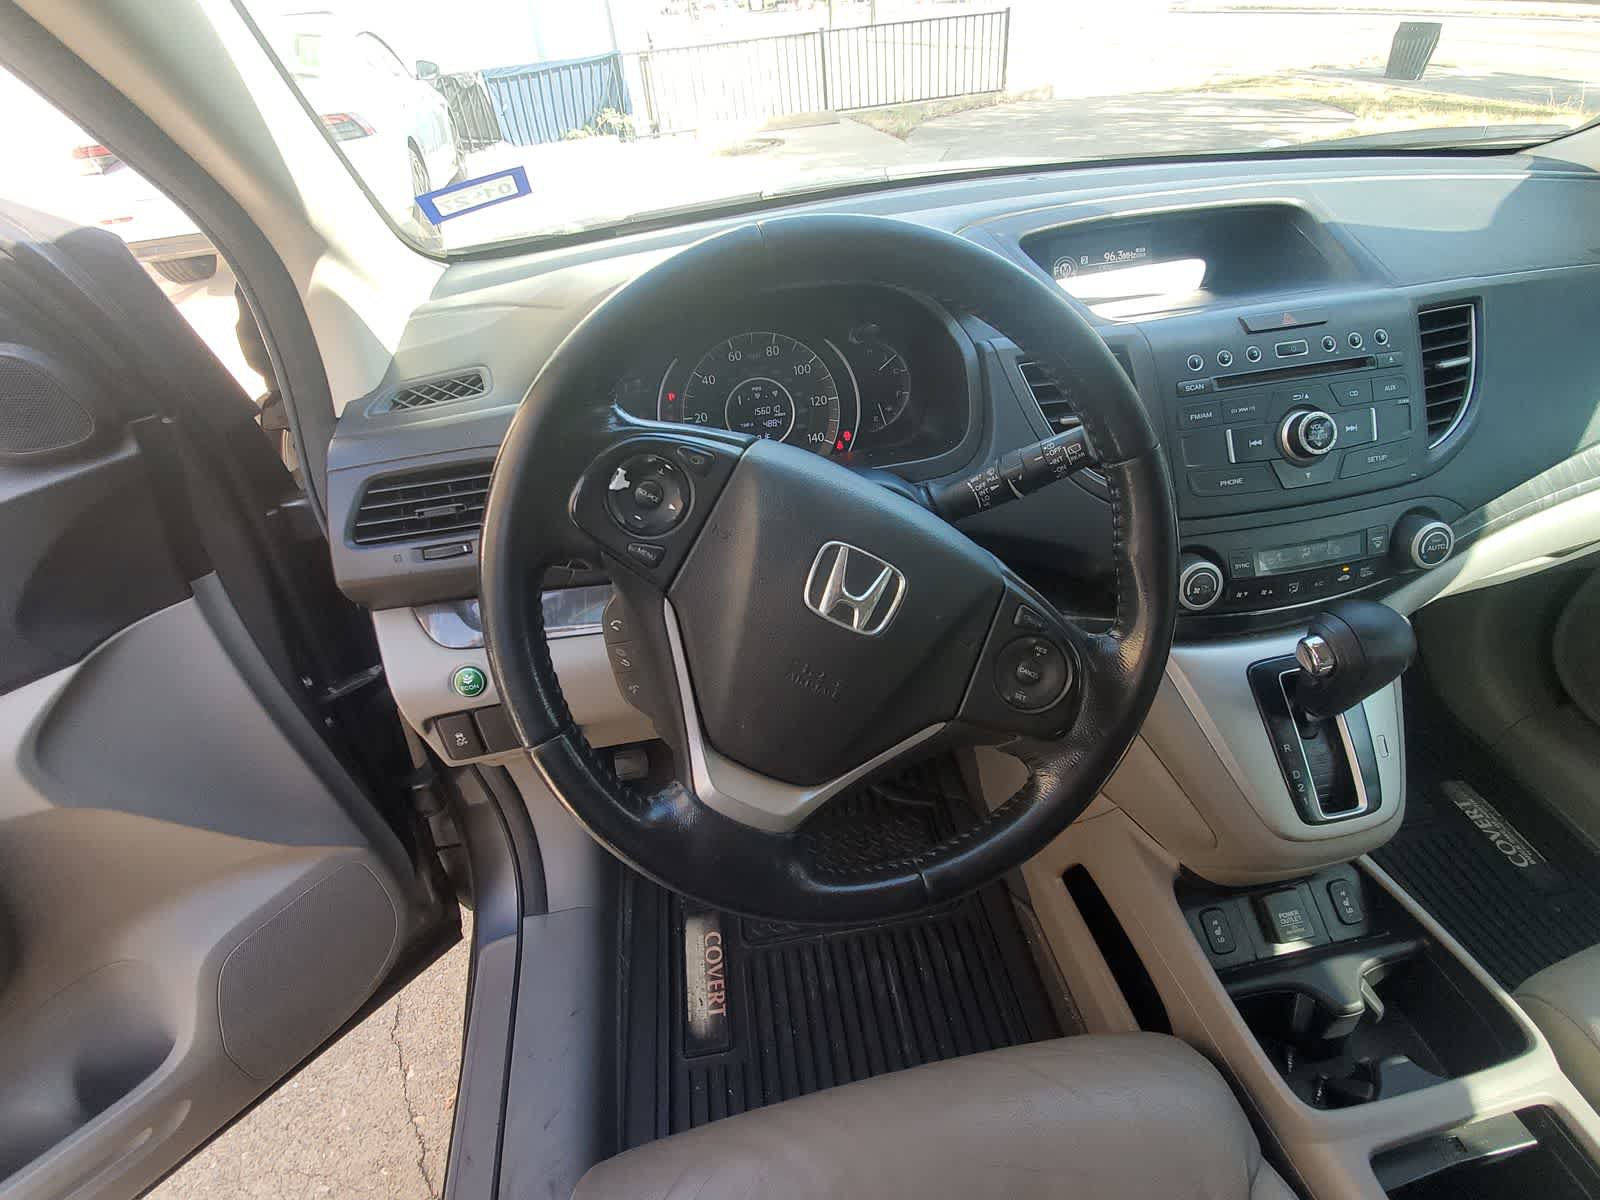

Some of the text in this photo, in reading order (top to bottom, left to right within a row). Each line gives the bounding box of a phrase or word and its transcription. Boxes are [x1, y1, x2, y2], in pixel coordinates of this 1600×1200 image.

[766, 345, 780, 357] 80
[728, 351, 742, 362] 60
[793, 364, 812, 376] 100
[701, 374, 716, 385] 40
[1185, 383, 1205, 392] SCAN
[1349, 390, 1359, 398] CD
[810, 396, 828, 407] 120
[695, 413, 708, 424] 20
[1190, 412, 1213, 421] FM/AM
[808, 432, 826, 443] 140
[1366, 454, 1388, 463] SETUP
[1219, 478, 1245, 488] PHONE
[1427, 543, 1446, 552] AUTO
[460, 683, 480, 691] ECON
[1283, 743, 1292, 753] R
[1292, 770, 1301, 780] D
[1297, 783, 1305, 793] 2
[704, 930, 727, 1017] COVERT
